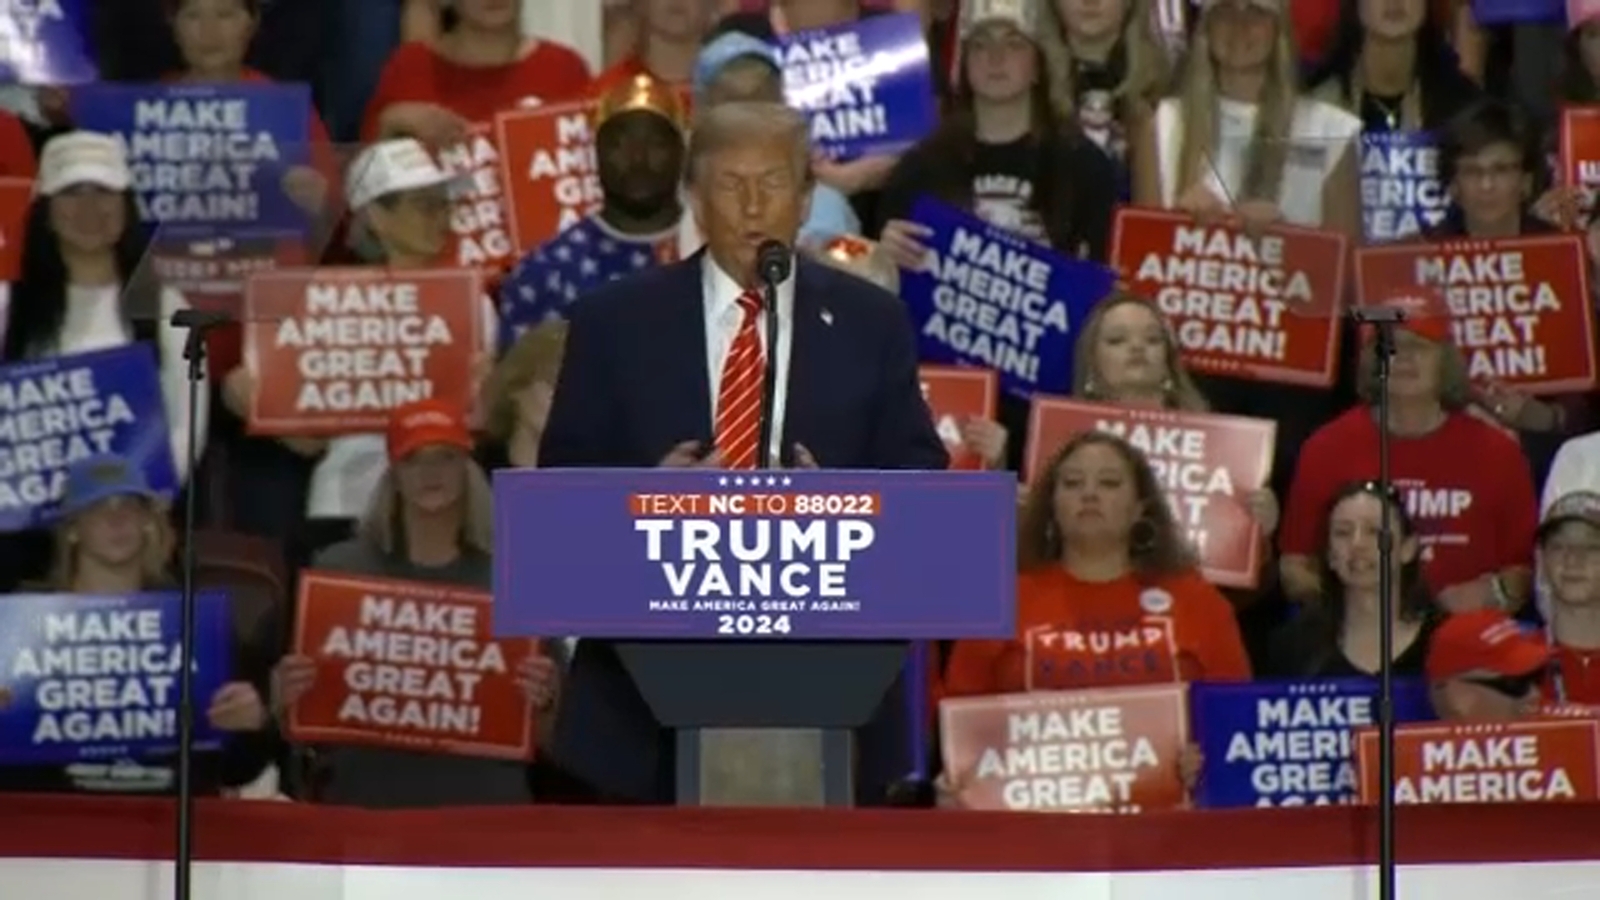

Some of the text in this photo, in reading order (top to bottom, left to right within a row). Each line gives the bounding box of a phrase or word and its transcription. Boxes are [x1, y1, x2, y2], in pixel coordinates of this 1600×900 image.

[774, 32, 860, 65] AKE
[135, 100, 248, 129] MAKE
[812, 103, 887, 138] AIN!
[440, 136, 500, 168] MA
[1361, 146, 1438, 178] AKE
[951, 226, 1052, 291] MAKE
[1416, 252, 1524, 285] MAKE
[1136, 252, 1313, 302] AMERICA
[306, 283, 419, 313] MAKE
[1158, 286, 1286, 327] GREAT
[1446, 282, 1561, 316] ERICA
[276, 315, 453, 347] AMERICA
[933, 283, 1045, 351] GREAT
[1453, 316, 1538, 348] EAT
[923, 312, 1040, 383] AGAIN!
[1165, 317, 1288, 361] GAIN!
[299, 347, 430, 379] GREAT
[1469, 345, 1546, 380] AIN!
[0, 394, 136, 440] MERICA
[637, 494, 875, 515] TEXT NC TO 88022
[634, 518, 877, 563] TRUMP
[661, 561, 848, 598] VANCE
[360, 595, 478, 638] MAKE
[649, 599, 861, 612] MAKE AMERICA GREAT AGAIN!
[44, 609, 162, 642] MAKE
[717, 614, 792, 635] 2024
[1037, 628, 1164, 655] TRUMP
[322, 625, 507, 674] AMERICA
[36, 676, 173, 711] GREAT
[344, 661, 482, 702] GREAT
[33, 708, 177, 743] AGAIN!
[337, 693, 482, 735] AGAIN!
[1008, 707, 1121, 742] MAKE
[1257, 696, 1373, 728] MAKE
[977, 736, 1158, 778] AMERICA
[1225, 730, 1350, 762] AMERI
[1422, 735, 1539, 772] MAKE
[1003, 772, 1137, 811] GREAT
[1251, 762, 1359, 794] GREA
[1394, 768, 1575, 805] AMERICA
